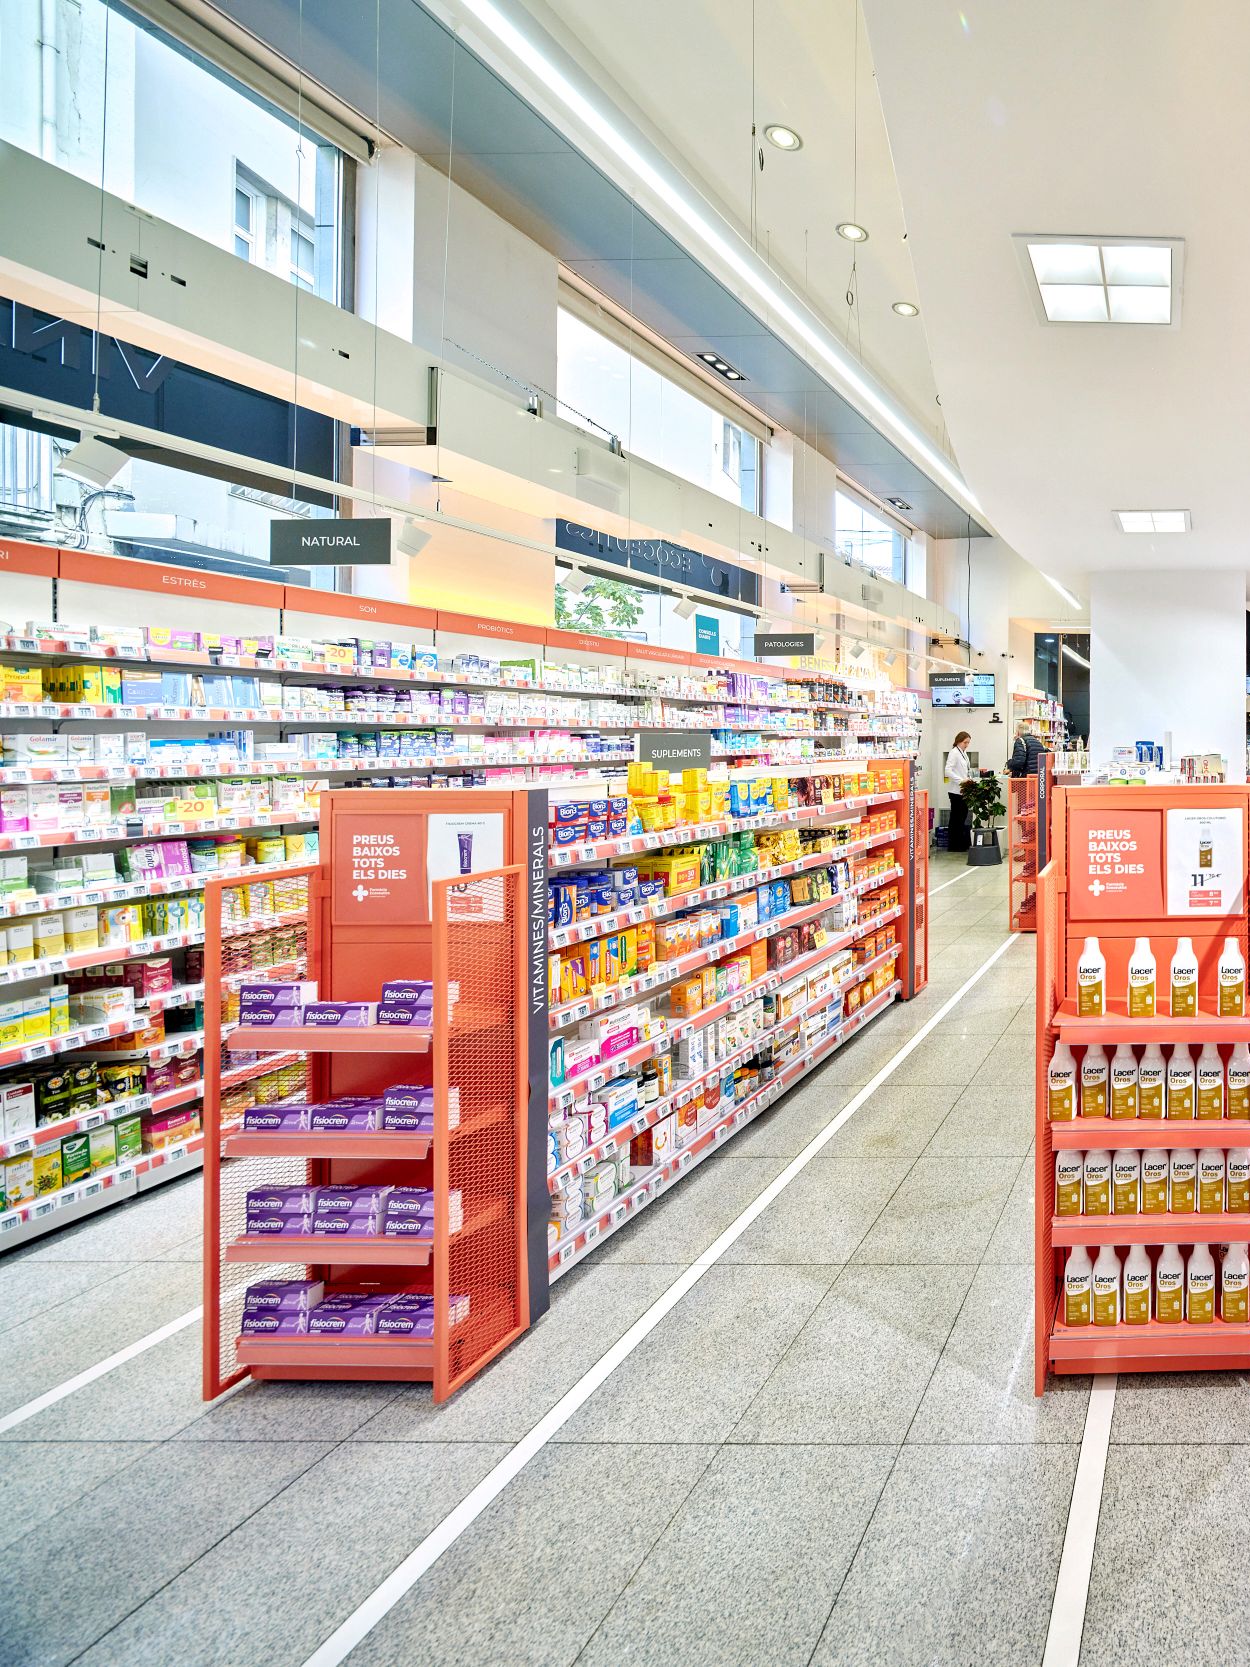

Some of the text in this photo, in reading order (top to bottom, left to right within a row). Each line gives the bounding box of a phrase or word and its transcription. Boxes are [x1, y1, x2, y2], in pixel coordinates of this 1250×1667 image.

[301, 536, 361, 547] NATURAL
[162, 575, 207, 589] ESTRÈS
[359, 605, 377, 614] SON
[477, 623, 514, 634] PROBIÒTICS
[992, 712, 1000, 722] 5
[651, 748, 701, 760] SUPLEMENTS
[593, 800, 606, 809] Bion3
[560, 806, 576, 815] Bion3
[612, 820, 624, 828] Bion3
[558, 829, 574, 838] Bion3
[1088, 830, 1131, 840] PREUS
[353, 835, 394, 844] PREUS
[1088, 841, 1137, 851] BAIXOS
[353, 847, 400, 856] BAIXOS
[352, 858, 384, 868] TOTS
[1088, 853, 1121, 863] TOTS
[1088, 864, 1144, 874] ELS DIES
[353, 870, 406, 879] ELS DIES
[1192, 874, 1204, 886] 11
[642, 885, 654, 894] Bion3
[532, 826, 544, 1014] VITAMINES/MINERALS
[1079, 966, 1101, 974] Lacer
[1131, 967, 1154, 975] Lacer
[1174, 967, 1195, 975] Lacer
[1221, 966, 1243, 974] Lacer
[242, 991, 274, 1001] fisiocrem
[384, 990, 418, 1000] fisiocrem
[306, 1011, 340, 1021] fisiocrem
[1050, 1070, 1072, 1078] Lacer
[246, 1115, 281, 1126] fisiocrem
[385, 1115, 419, 1125] fisiocrem
[1201, 1163, 1224, 1171] Lacer
[248, 1198, 283, 1209] fisiocrem
[314, 1220, 349, 1231] fisiocrem
[1067, 1274, 1090, 1282] Lacer
[1224, 1271, 1247, 1279] Lacer
[310, 1318, 346, 1329] fisiocrem
